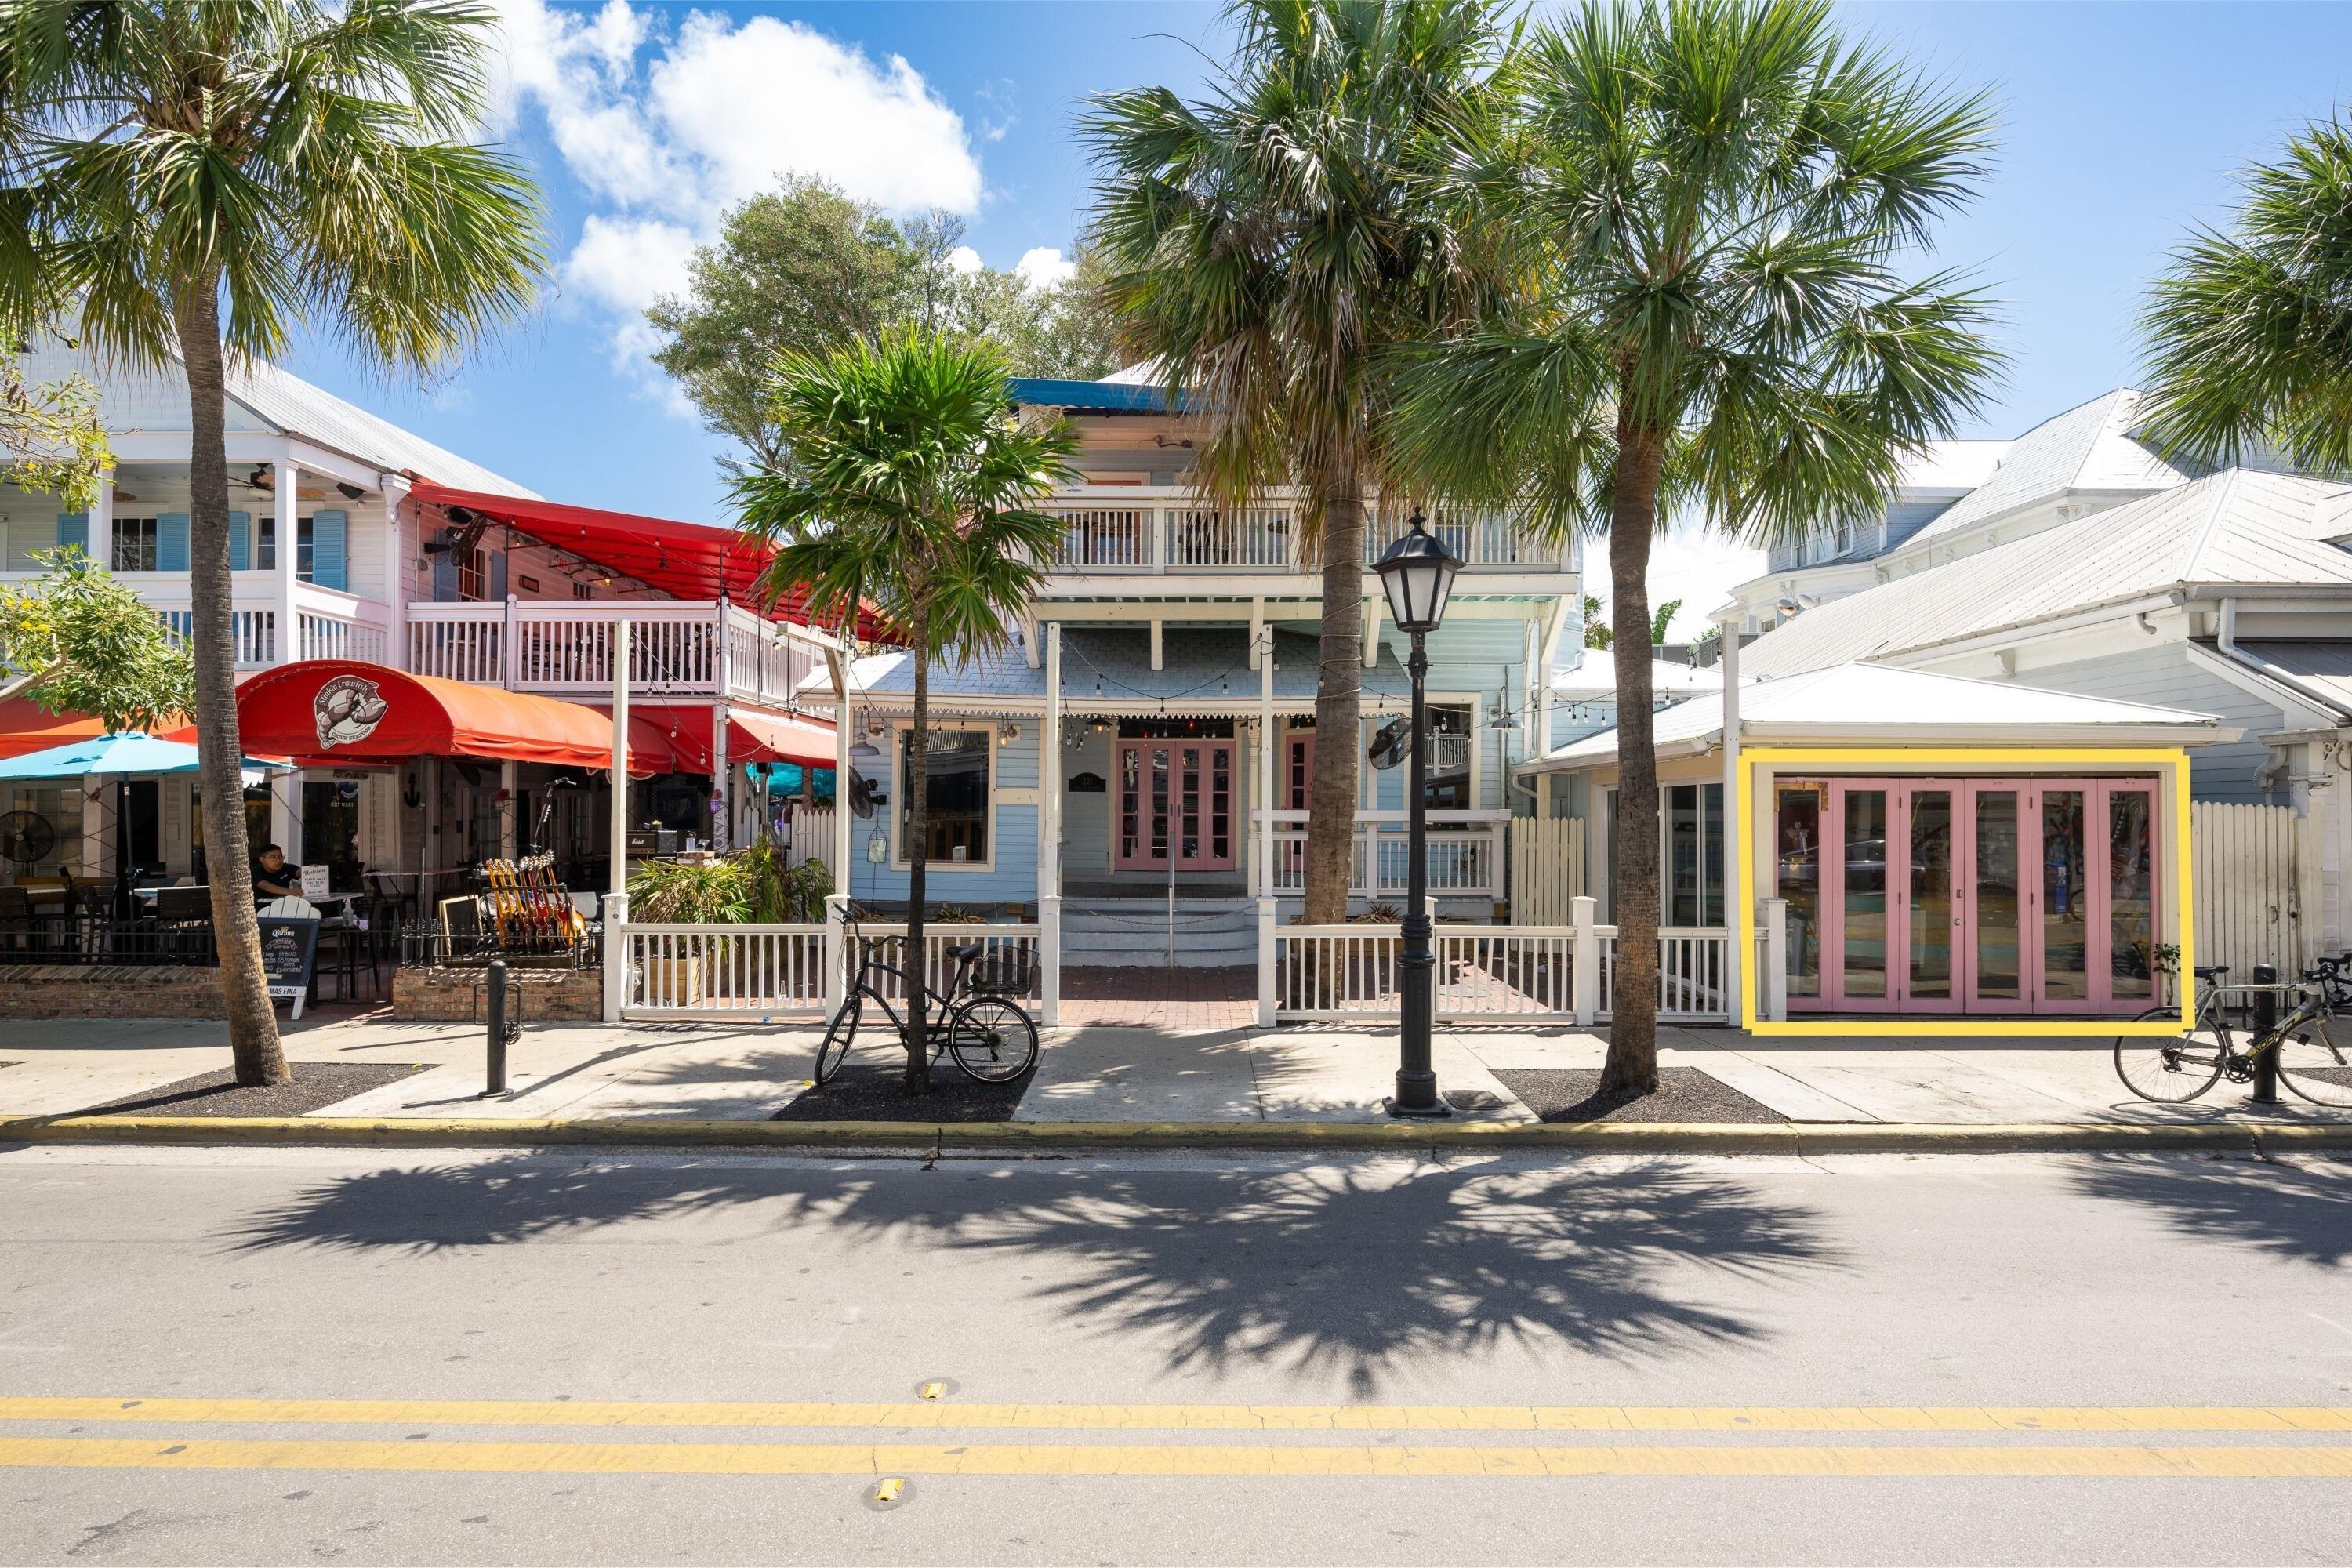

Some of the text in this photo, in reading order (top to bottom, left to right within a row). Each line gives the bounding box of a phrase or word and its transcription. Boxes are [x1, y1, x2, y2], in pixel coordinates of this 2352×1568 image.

[318, 681, 368, 706] Stinkin Crawfish
[349, 726, 372, 740] SEAFOOD
